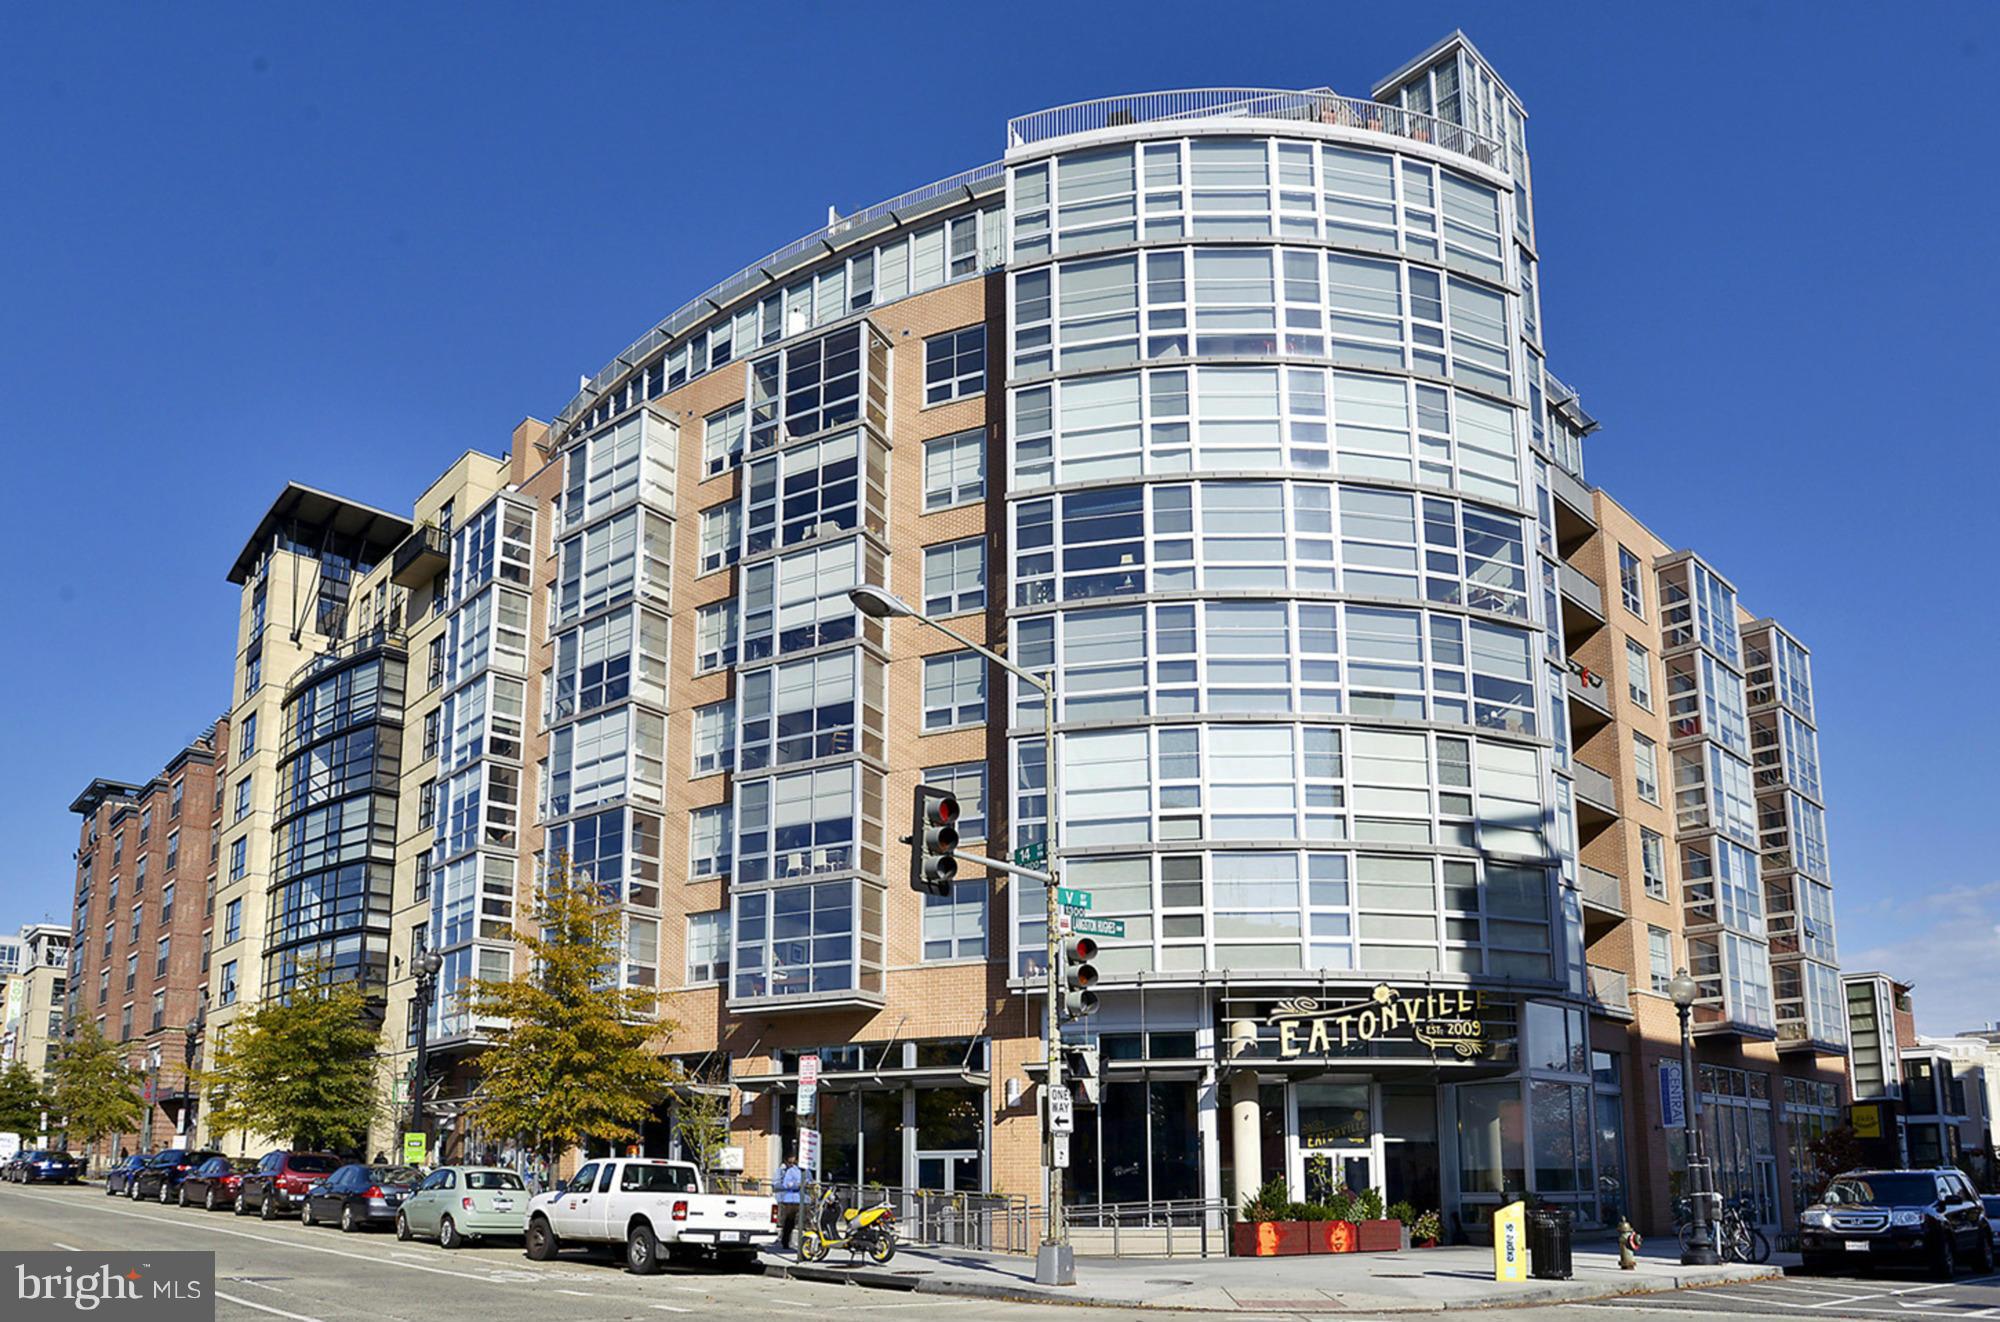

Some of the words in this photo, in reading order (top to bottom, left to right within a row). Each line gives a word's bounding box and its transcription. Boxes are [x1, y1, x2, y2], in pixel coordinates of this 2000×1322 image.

[1020, 848, 1031, 862] 14
[1065, 891, 1074, 904] V
[1280, 991, 1490, 1057] EATONVILLE
[1447, 1021, 1482, 1037] 2009
[1051, 1088, 1069, 1101] ONE
[1670, 1067, 1684, 1122] CENTRAL
[1051, 1102, 1070, 1113] WAY
